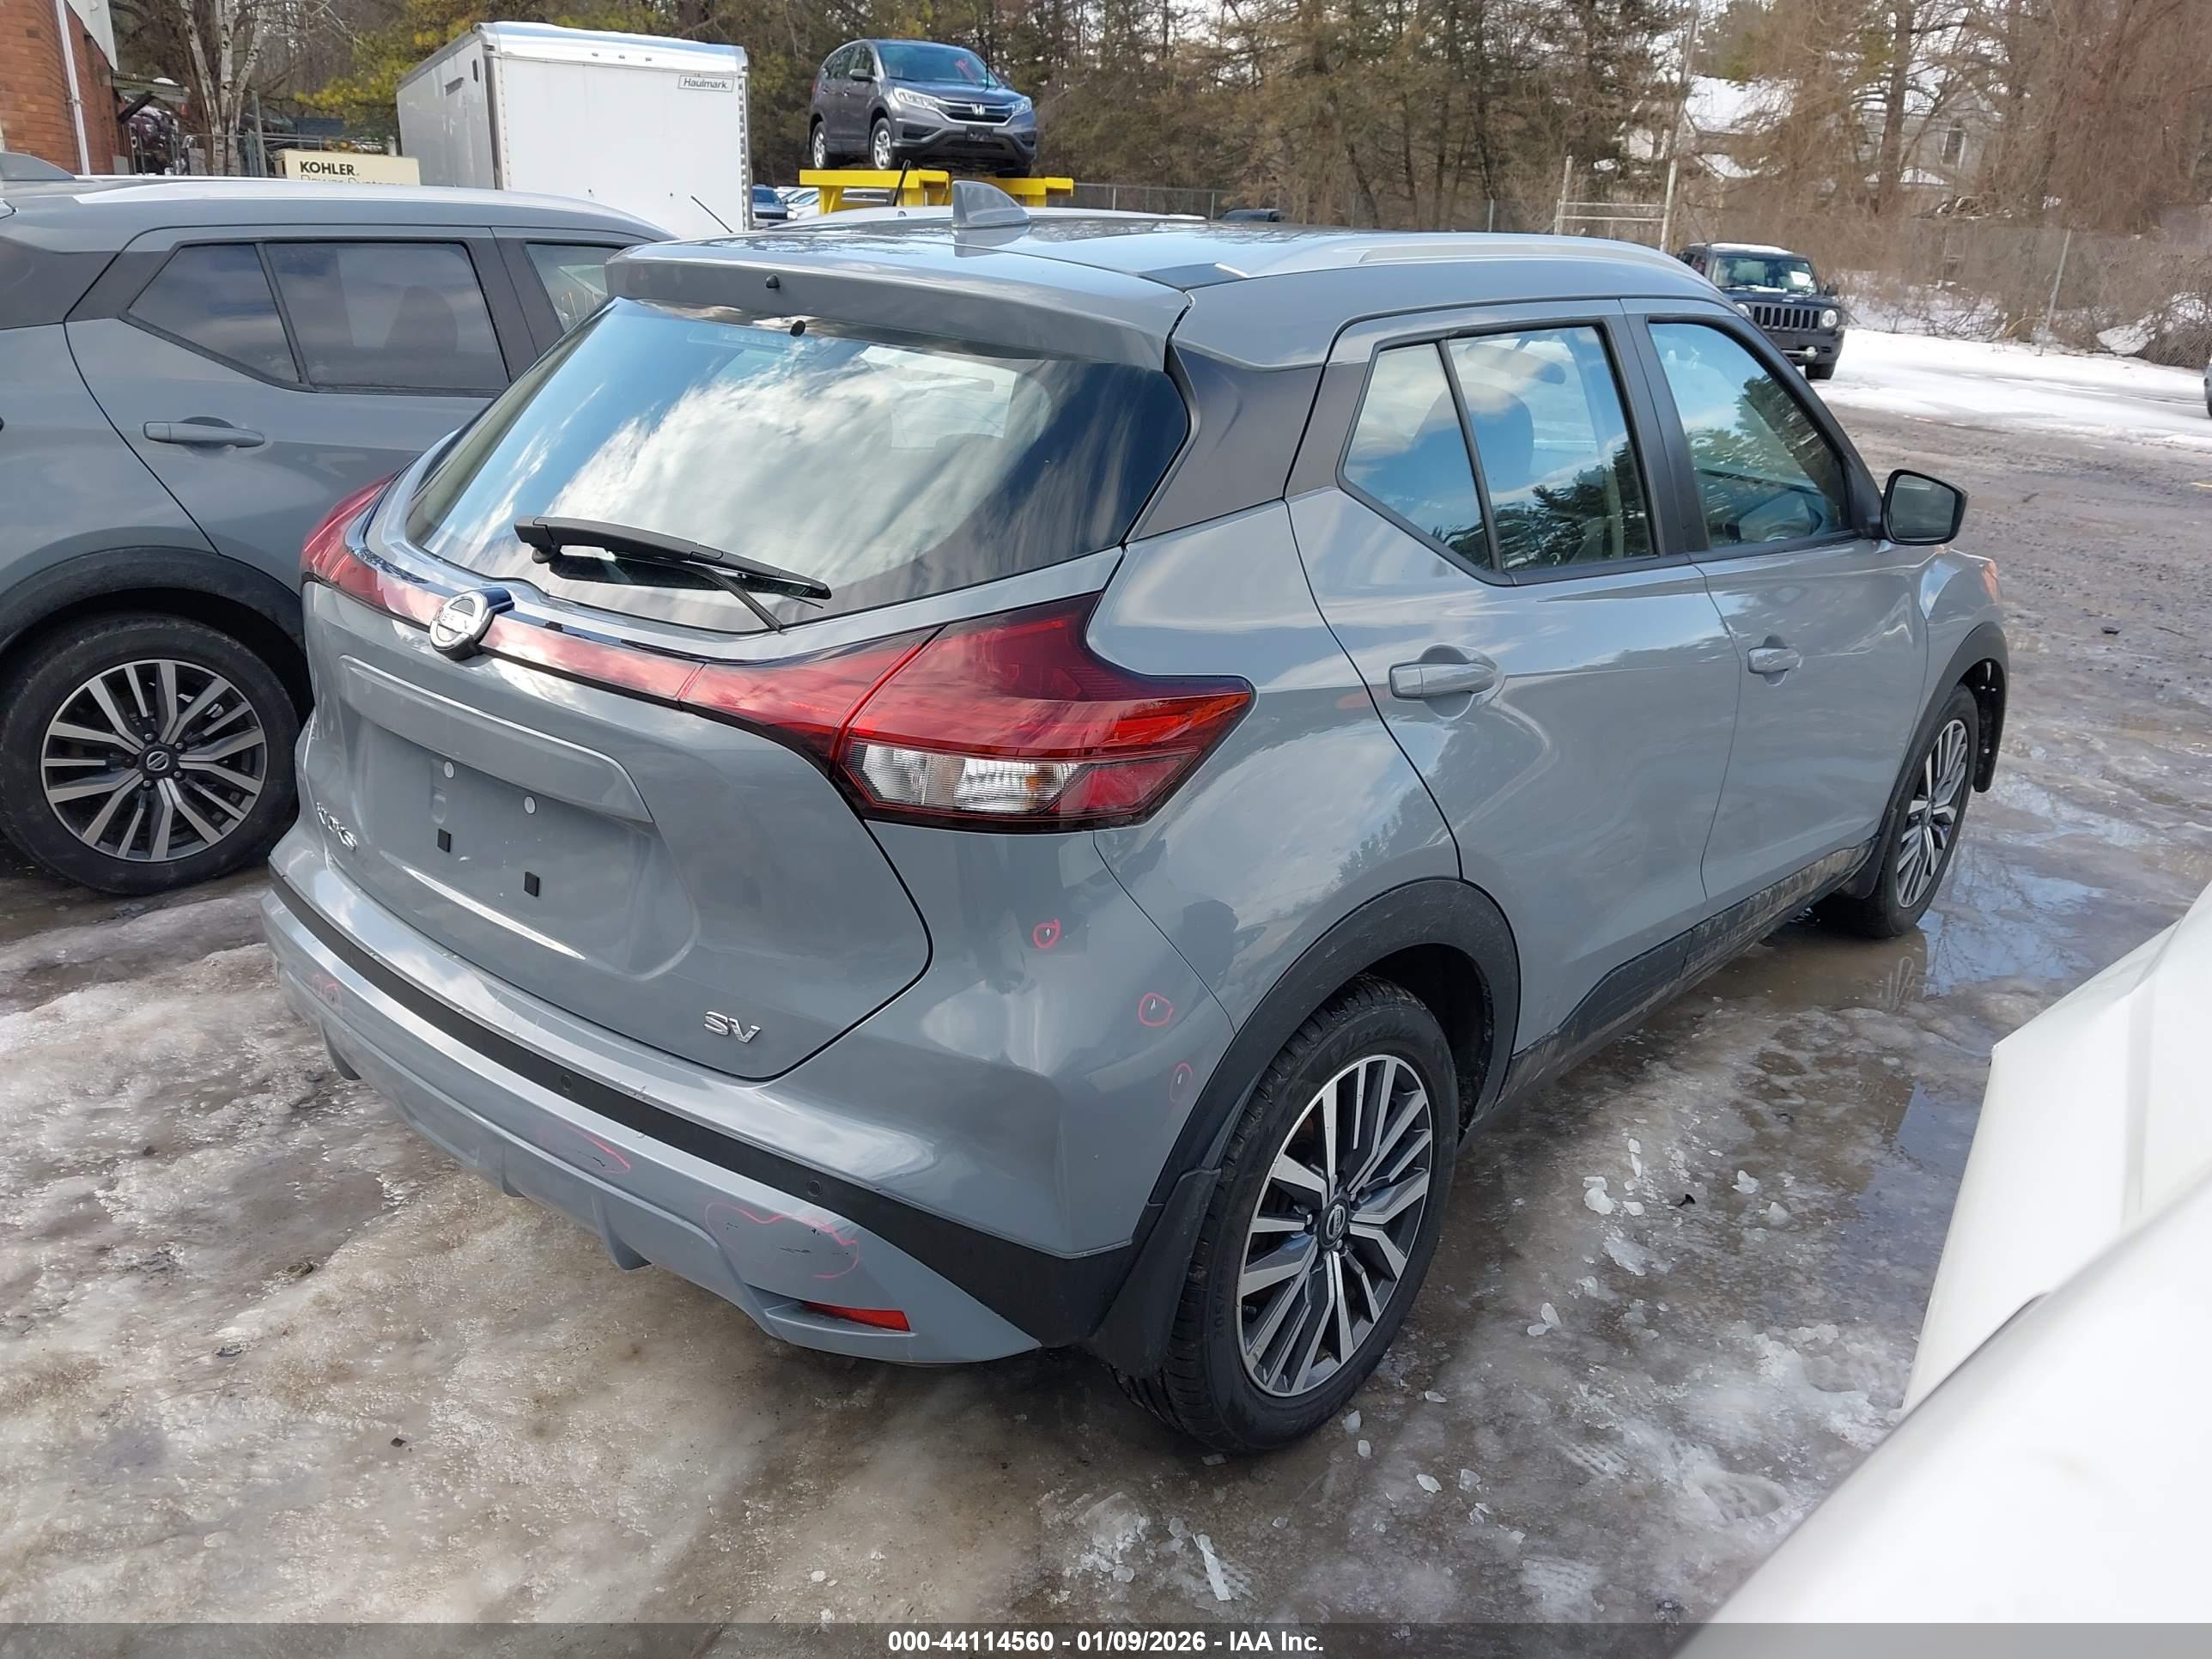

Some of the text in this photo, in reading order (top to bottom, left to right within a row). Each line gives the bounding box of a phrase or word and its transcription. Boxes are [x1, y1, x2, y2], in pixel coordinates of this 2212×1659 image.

[684, 77, 727, 89] Haulmark
[300, 161, 356, 176] KOHLER
[704, 1011, 762, 1043] SV
